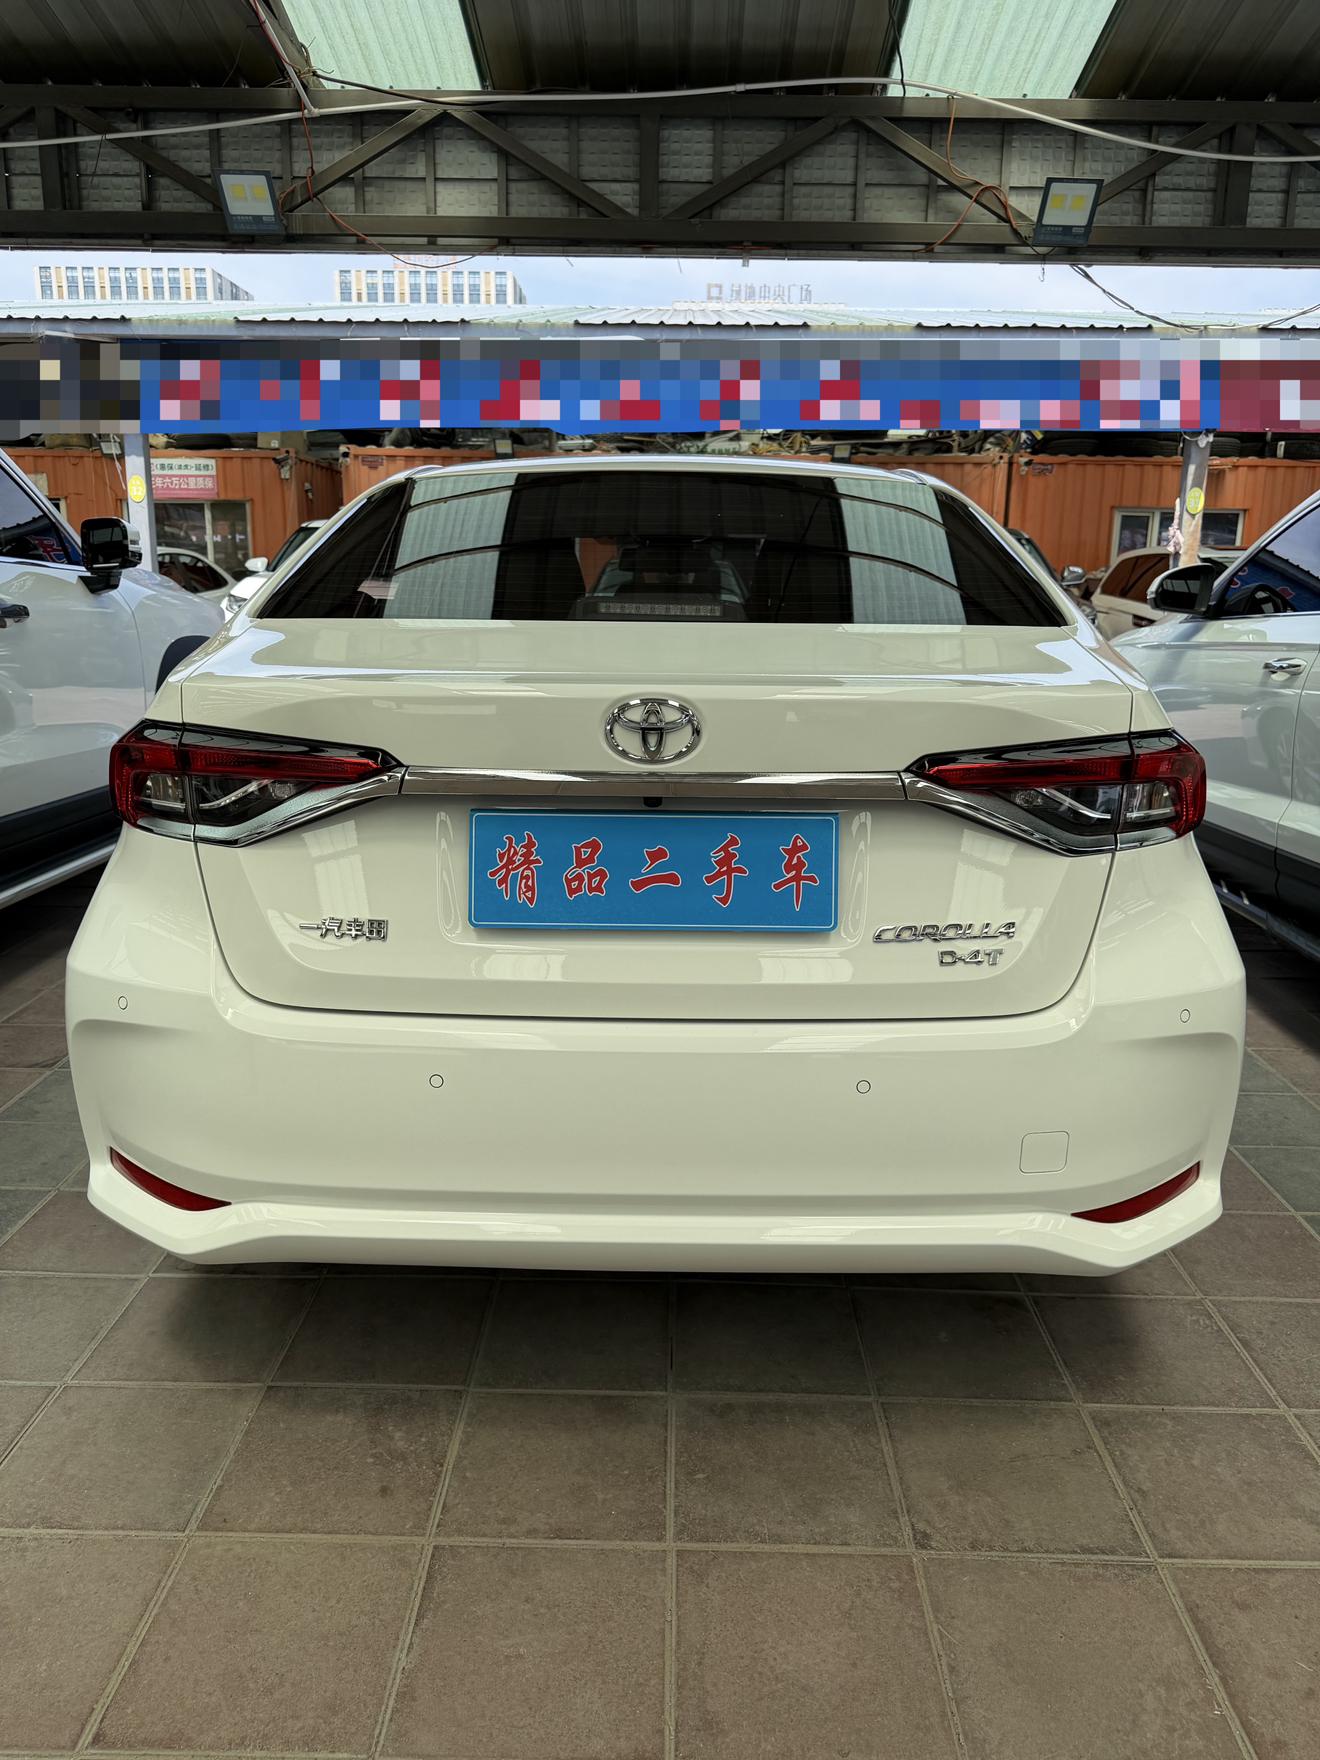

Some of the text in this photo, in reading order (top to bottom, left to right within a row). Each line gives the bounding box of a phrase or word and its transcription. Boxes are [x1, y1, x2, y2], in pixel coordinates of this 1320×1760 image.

[487, 831, 820, 911] 精品二手车
[299, 917, 388, 941] 一汽丰田
[873, 921, 1016, 943] COROLLA
[938, 948, 1004, 966] D-4T
